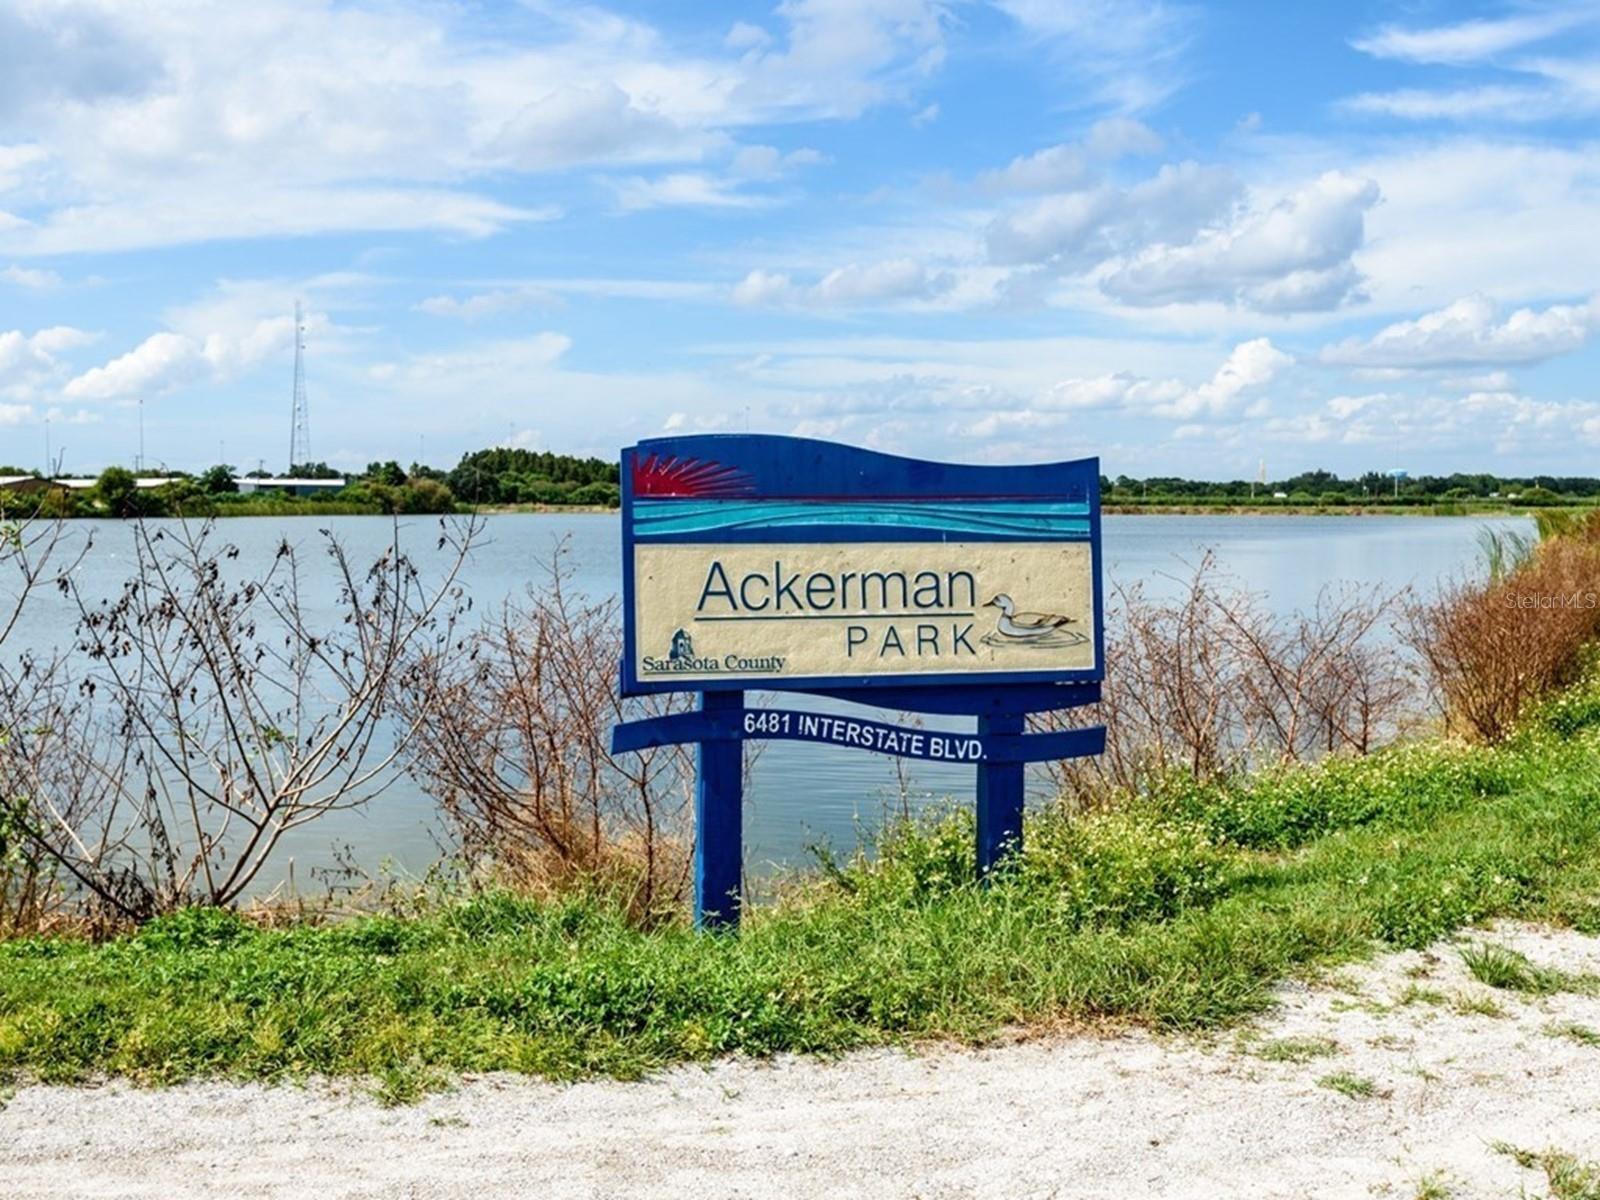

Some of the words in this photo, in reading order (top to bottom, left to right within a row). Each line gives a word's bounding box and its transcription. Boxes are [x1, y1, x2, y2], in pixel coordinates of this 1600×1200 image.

[699, 562, 976, 611] Ackerman
[847, 624, 976, 657] PARK
[642, 655, 720, 672] Sarasota
[724, 654, 786, 674] County
[744, 713, 791, 734] 6481
[798, 717, 924, 756] INTERSTATE
[929, 736, 988, 760] BLVD.
